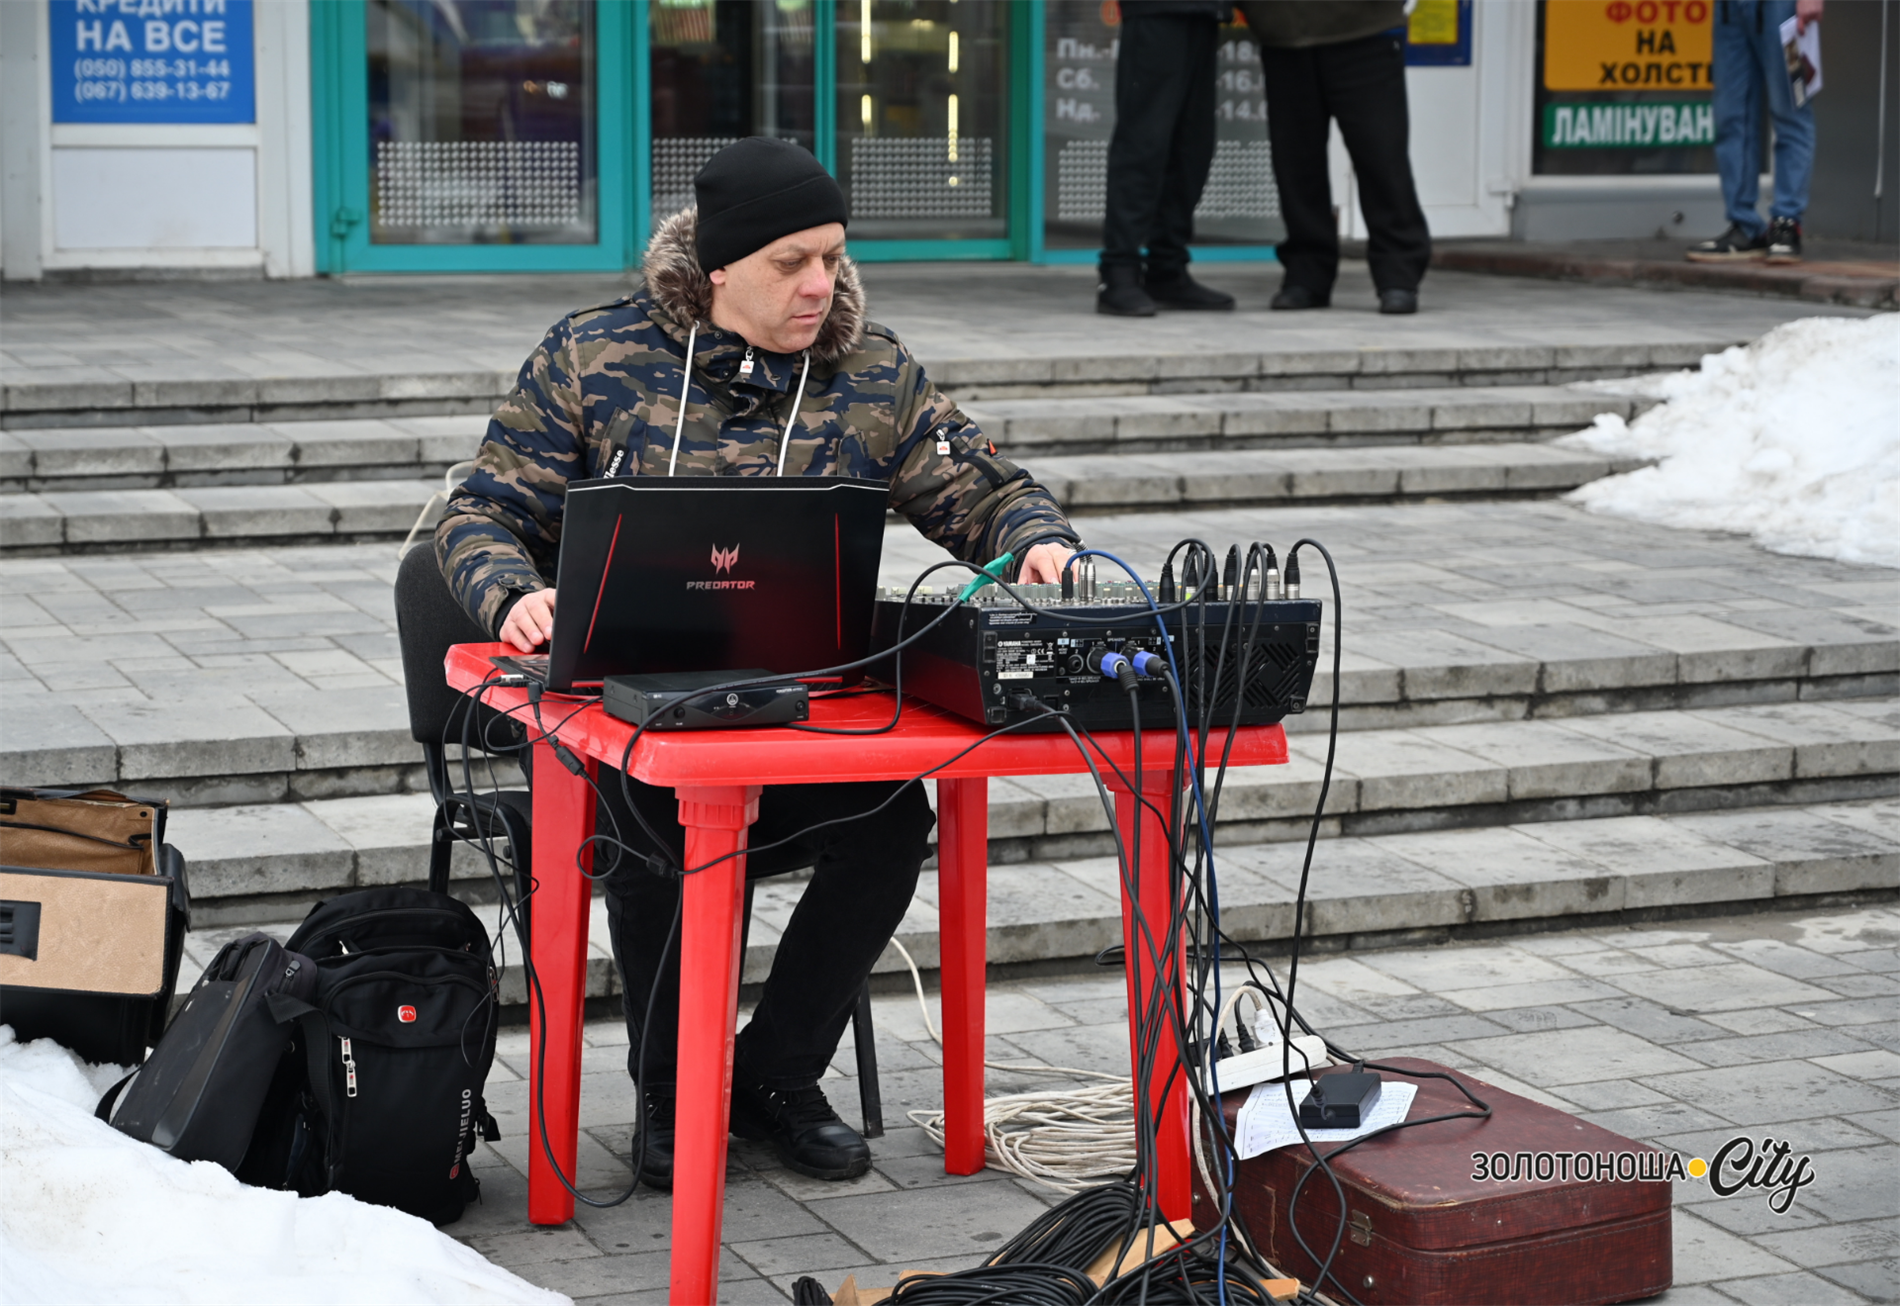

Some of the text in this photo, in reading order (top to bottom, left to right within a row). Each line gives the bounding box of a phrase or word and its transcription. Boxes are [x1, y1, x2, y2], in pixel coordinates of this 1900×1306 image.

[1605, 0, 1708, 25] ФОТО
[76, 20, 226, 52] НА ВСЕ
[1637, 29, 1676, 55] НА
[686, 581, 756, 591] PREDATOR
